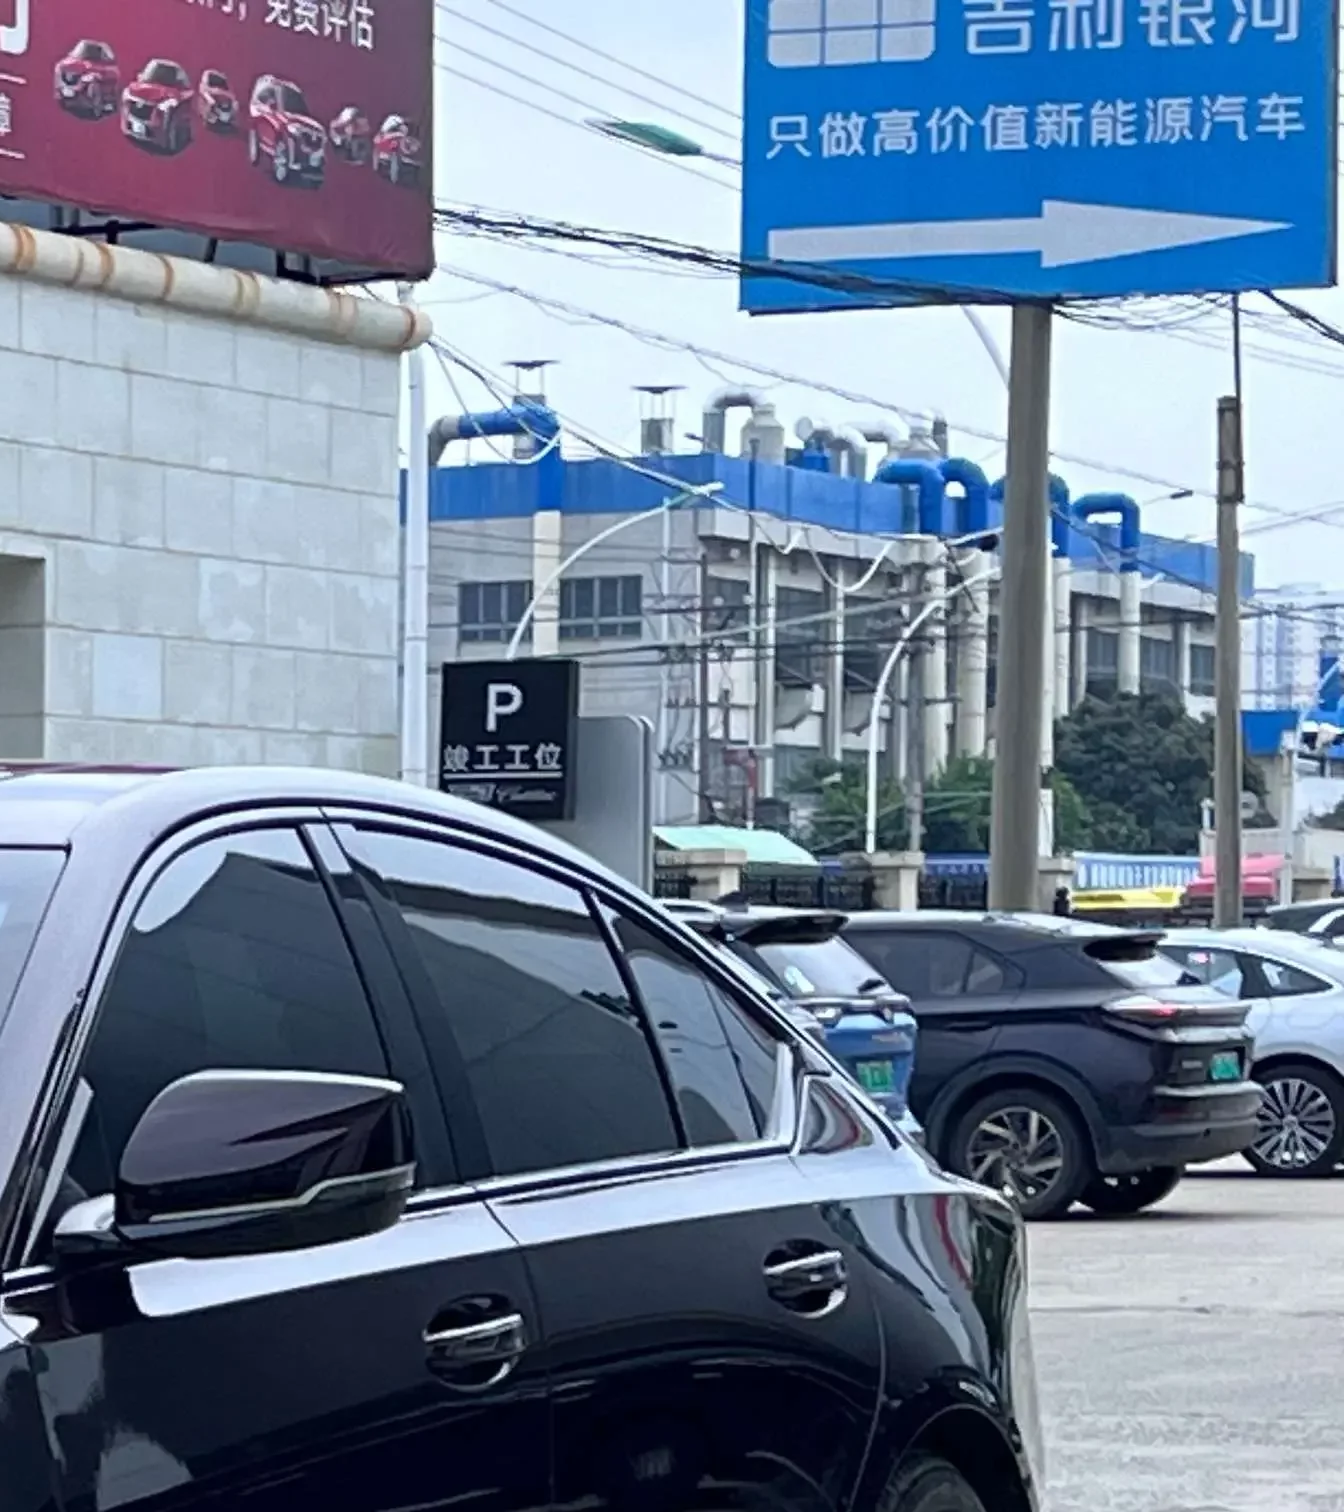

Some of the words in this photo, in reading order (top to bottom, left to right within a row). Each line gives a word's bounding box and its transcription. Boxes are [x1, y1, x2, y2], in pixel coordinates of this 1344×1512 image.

[766, 92, 1306, 159] 只做高价值新能源汽车
[486, 683, 523, 732] P
